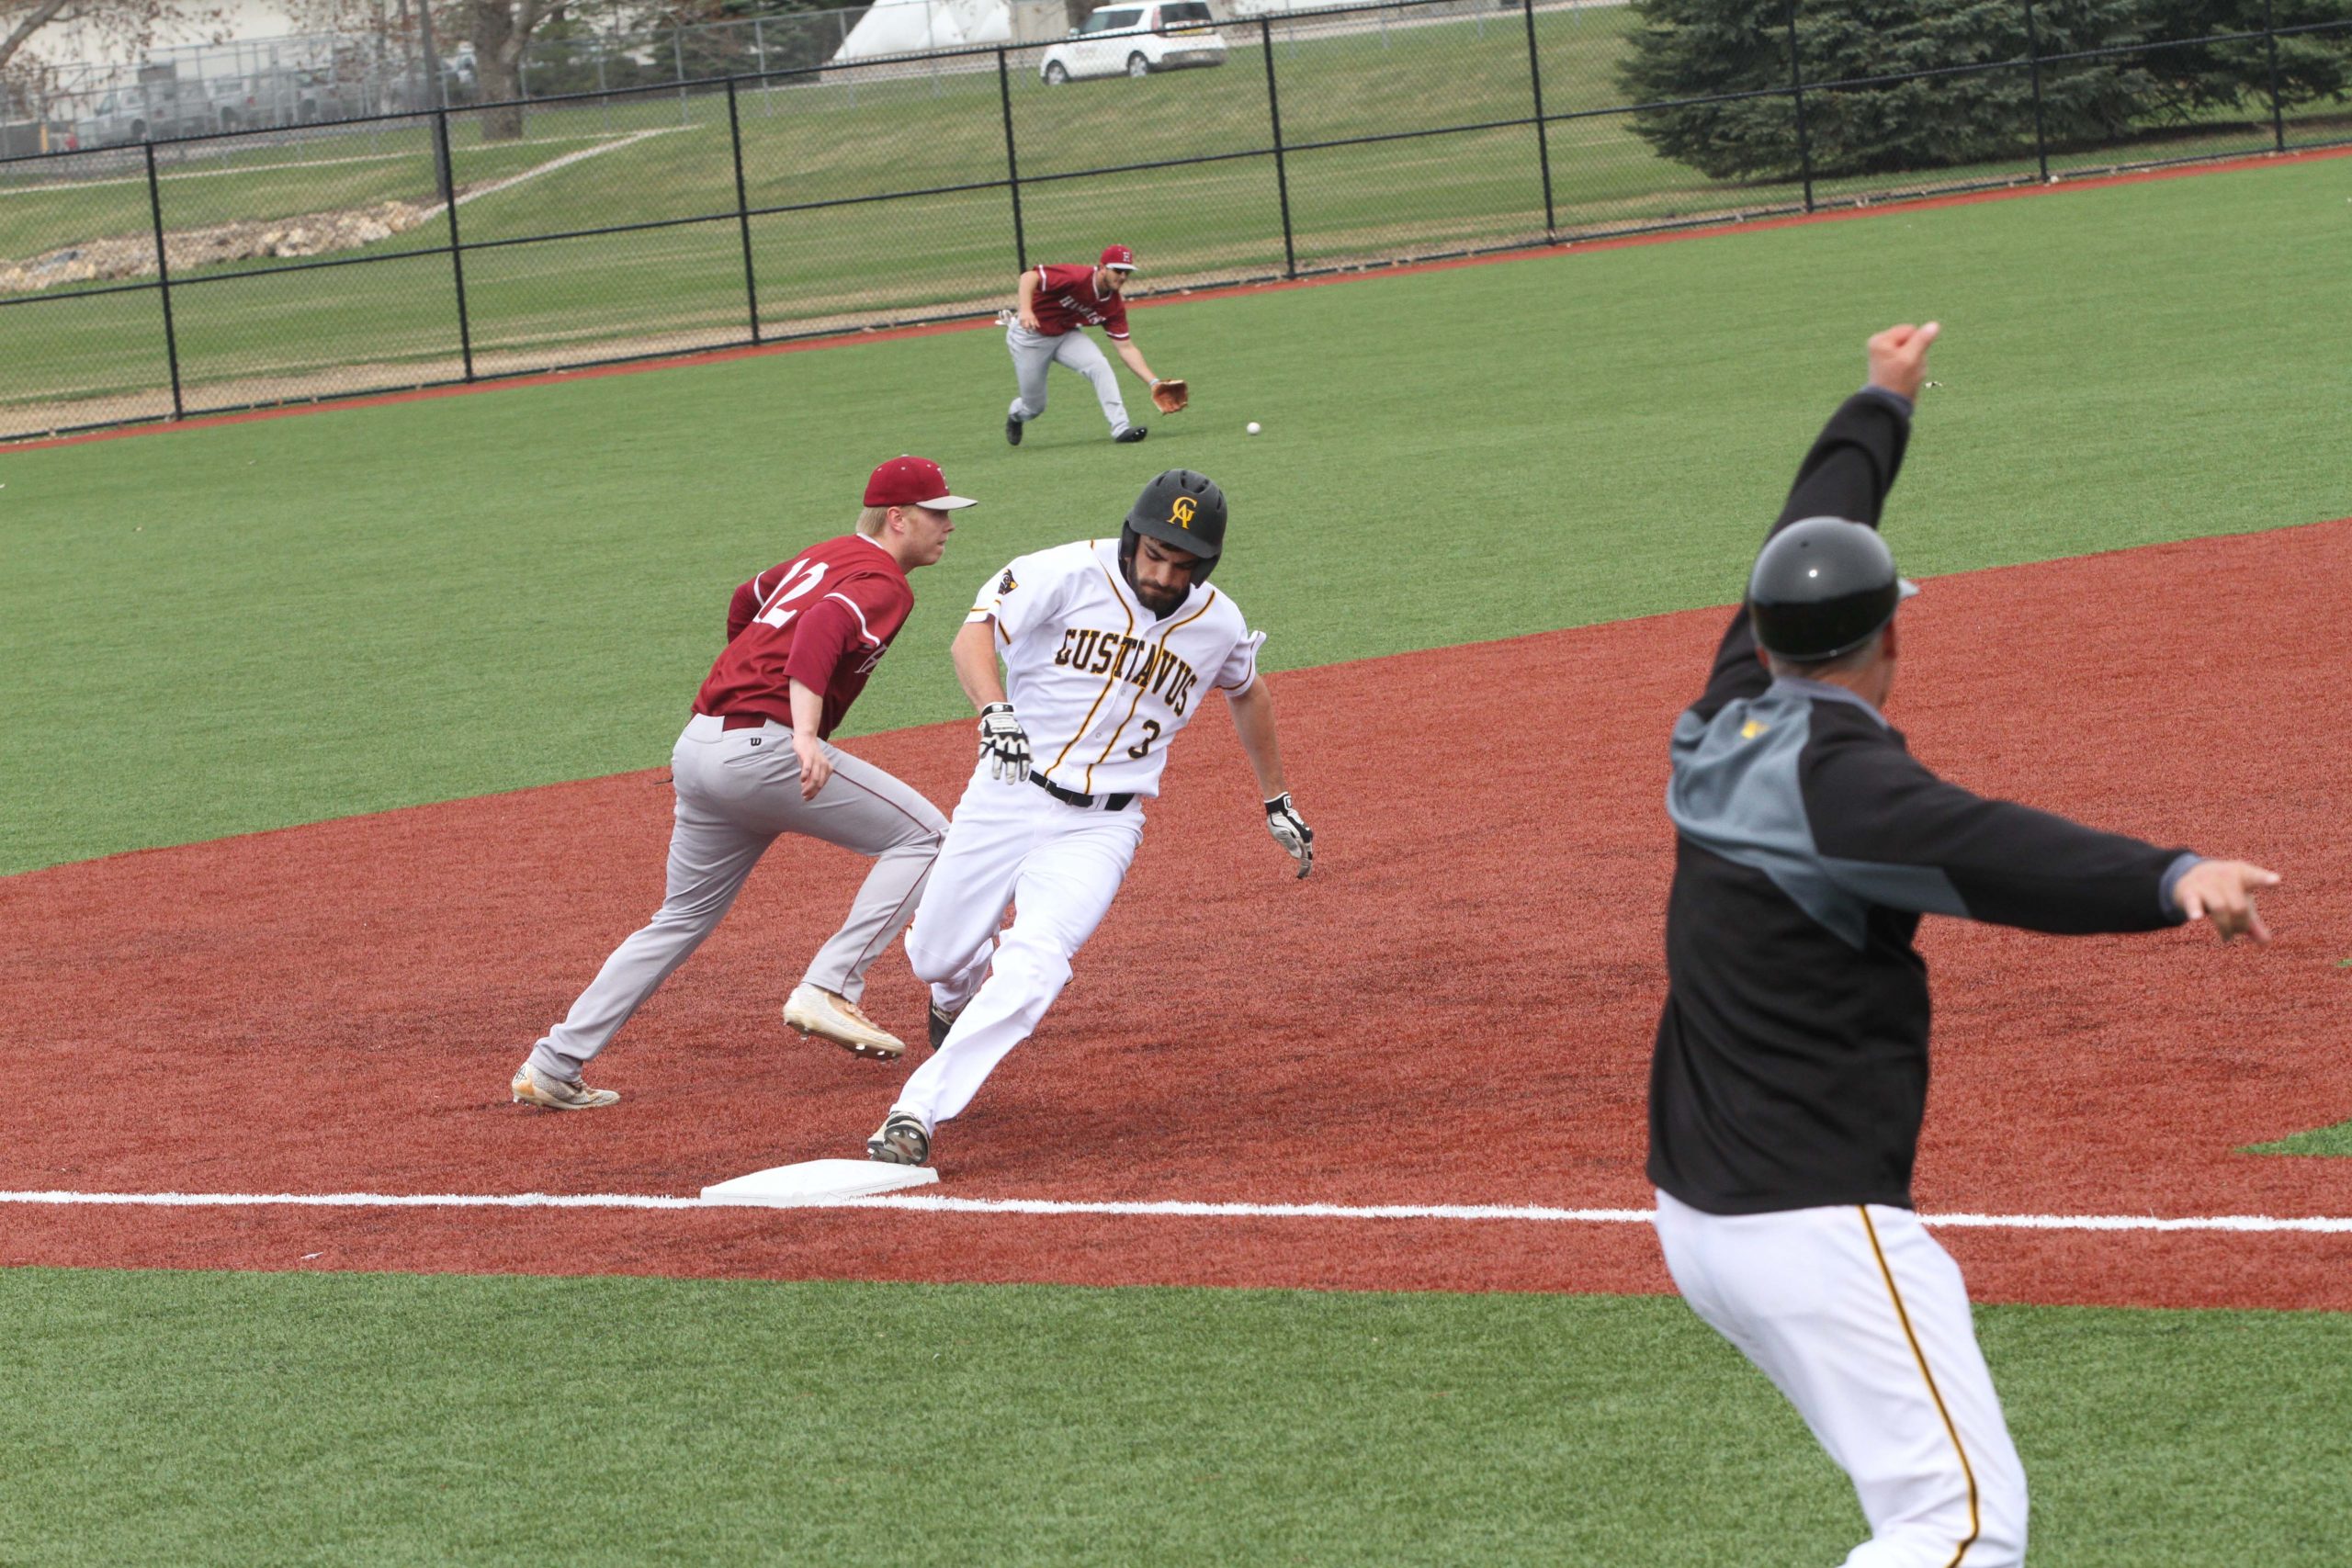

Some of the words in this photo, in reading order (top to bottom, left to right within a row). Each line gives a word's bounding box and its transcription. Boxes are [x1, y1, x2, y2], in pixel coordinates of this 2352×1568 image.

[752, 558, 829, 629] 12
[1055, 628, 1198, 717] GUSTAVUS
[1127, 719, 1161, 760] 3
